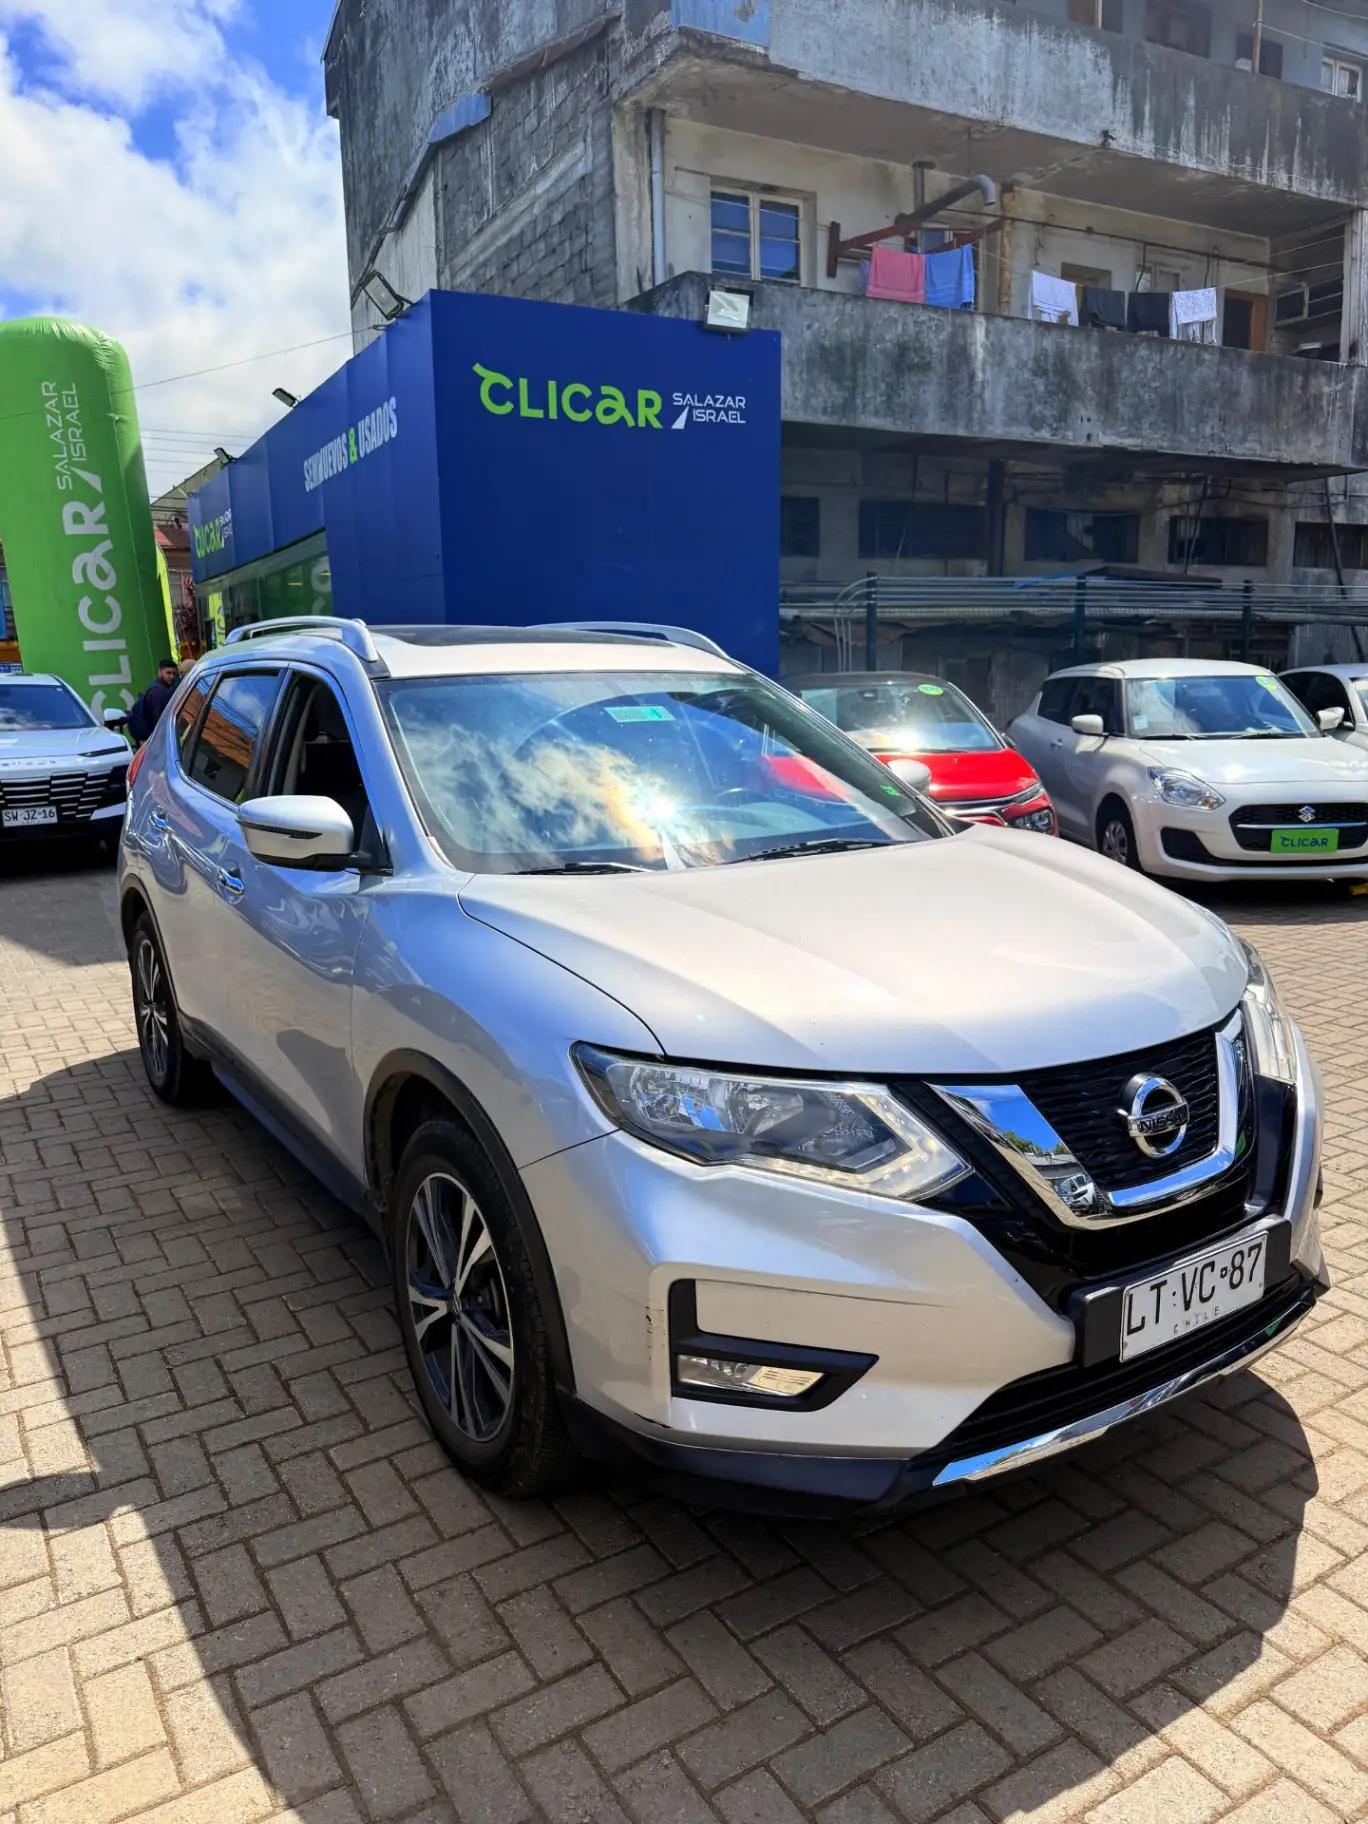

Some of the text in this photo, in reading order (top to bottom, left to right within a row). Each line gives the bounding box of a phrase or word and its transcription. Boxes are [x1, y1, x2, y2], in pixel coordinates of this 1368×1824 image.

[61, 382, 87, 461] ISRAEL
[672, 393, 746, 409] SALAZAR
[692, 409, 746, 424] ISRAEL
[41, 380, 73, 490] SALAZAR
[349, 427, 358, 464] &
[358, 396, 398, 458] USADOS
[1173, 1305, 1220, 1334] CHILE
